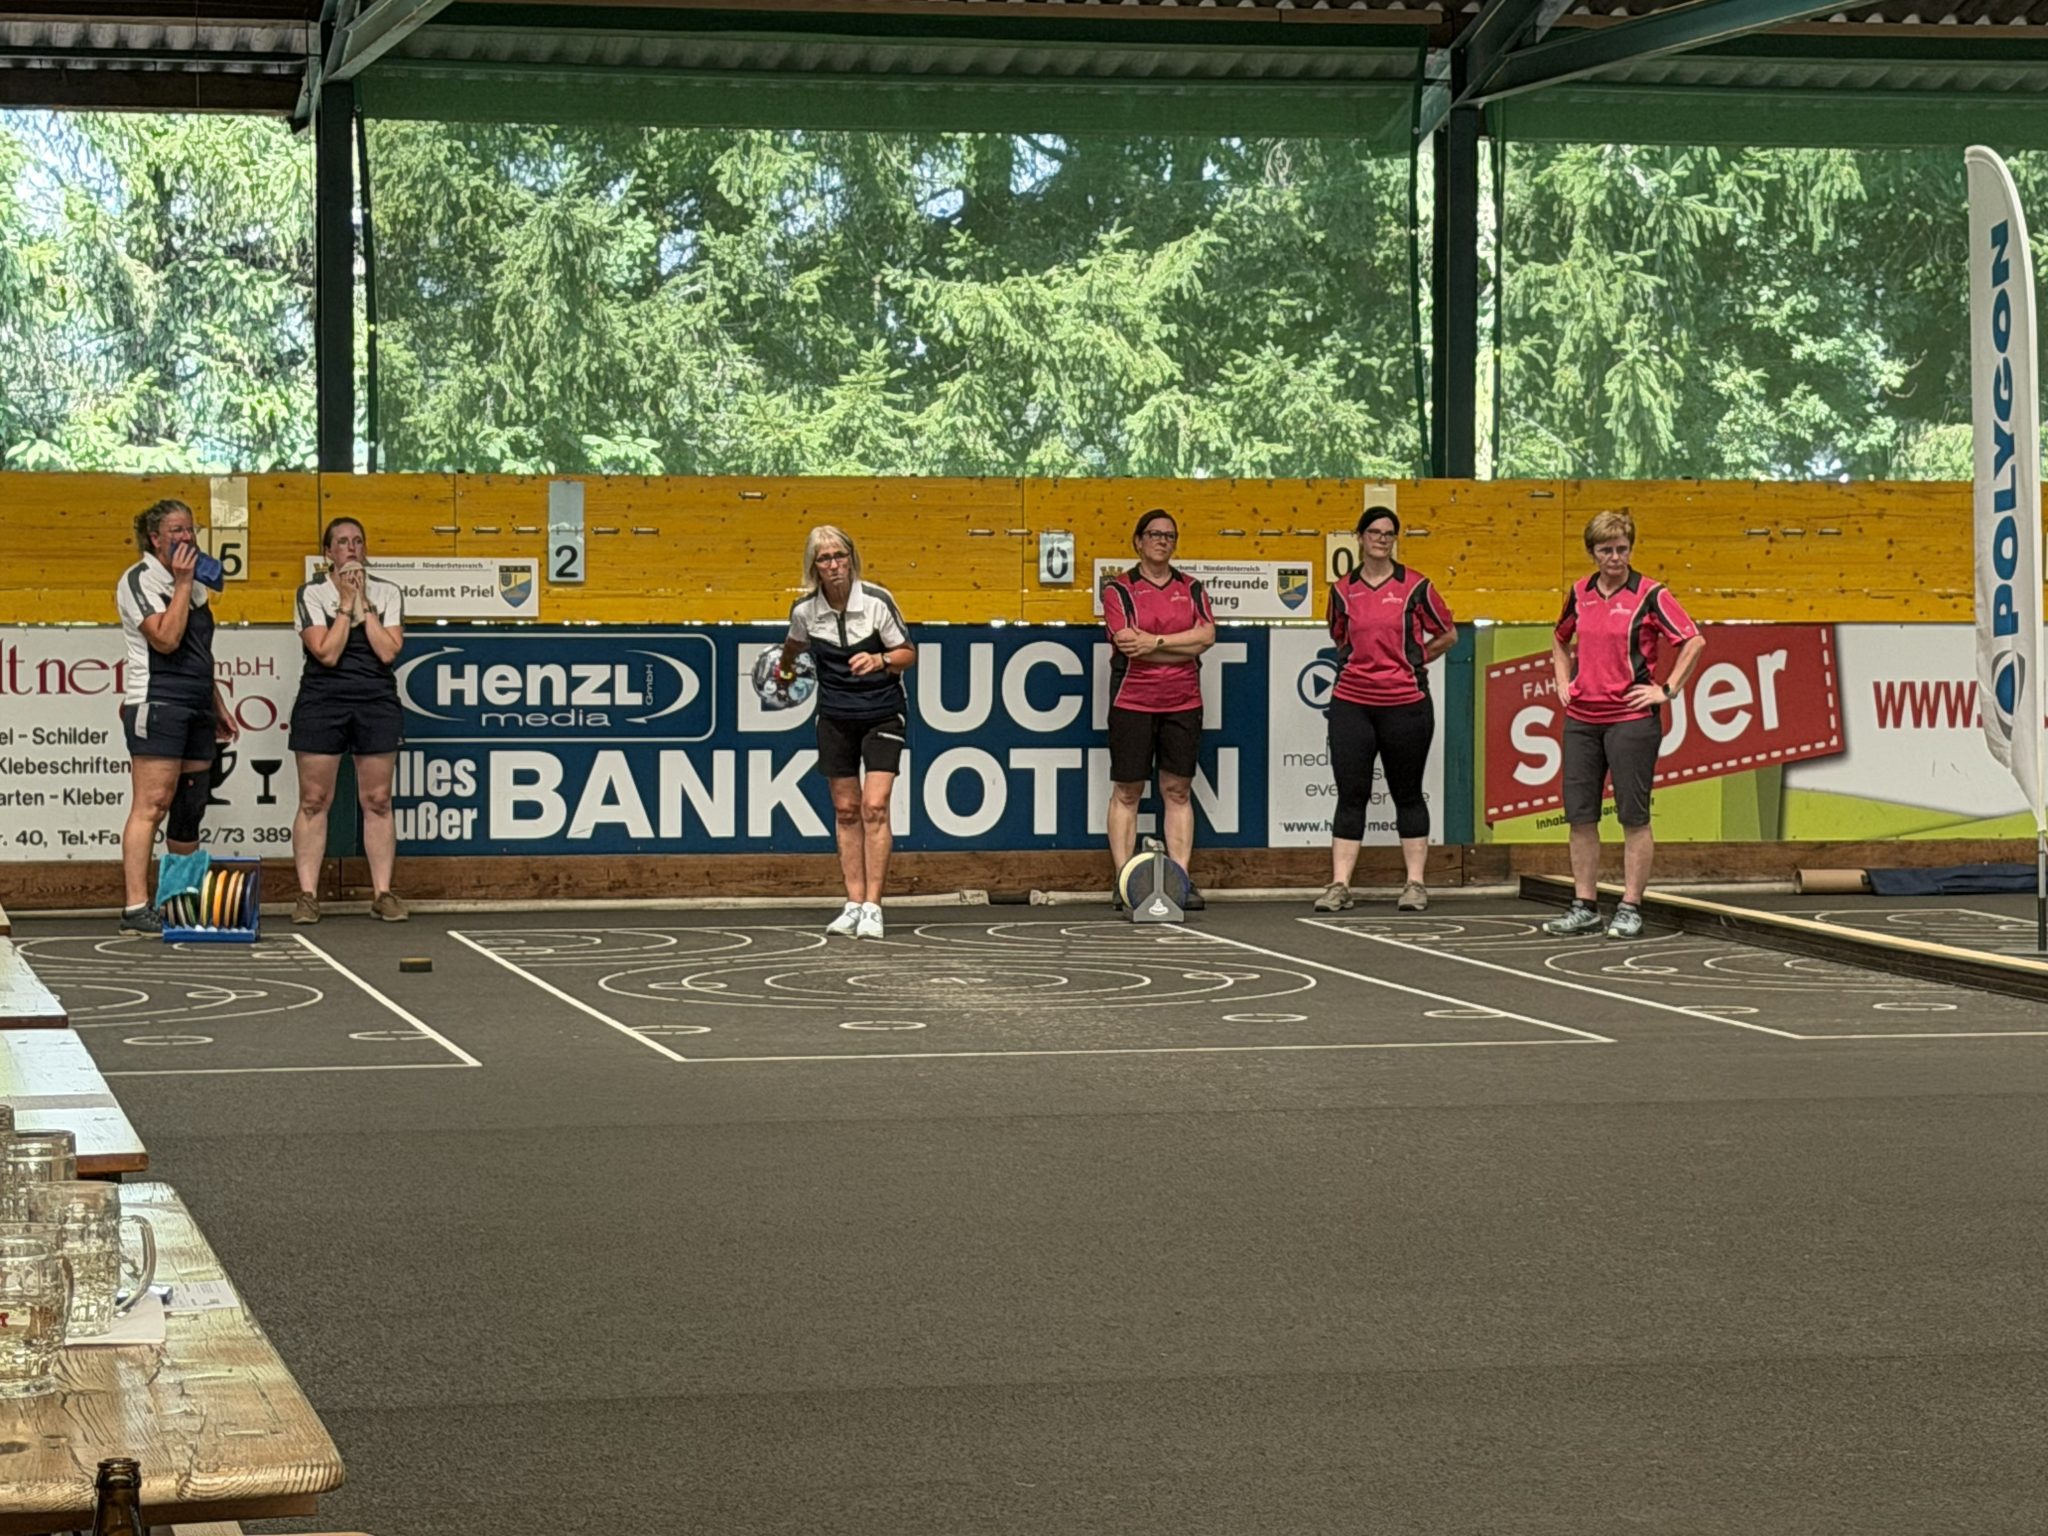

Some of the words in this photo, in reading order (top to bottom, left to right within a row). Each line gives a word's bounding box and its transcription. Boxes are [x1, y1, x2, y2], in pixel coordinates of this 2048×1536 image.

[1990, 219, 2019, 637] POLYGON
[220, 543, 242, 576] 5
[555, 545, 578, 577] 2
[1047, 546, 1068, 579] 0
[1332, 547, 1353, 580] 0
[460, 585, 494, 598] Priel
[481, 709, 611, 727] media
[32, 727, 108, 745] Schilder
[391, 750, 477, 797] lles
[63, 788, 124, 806] Kleber
[16, 829, 48, 848] 40,
[253, 827, 292, 844] 389
